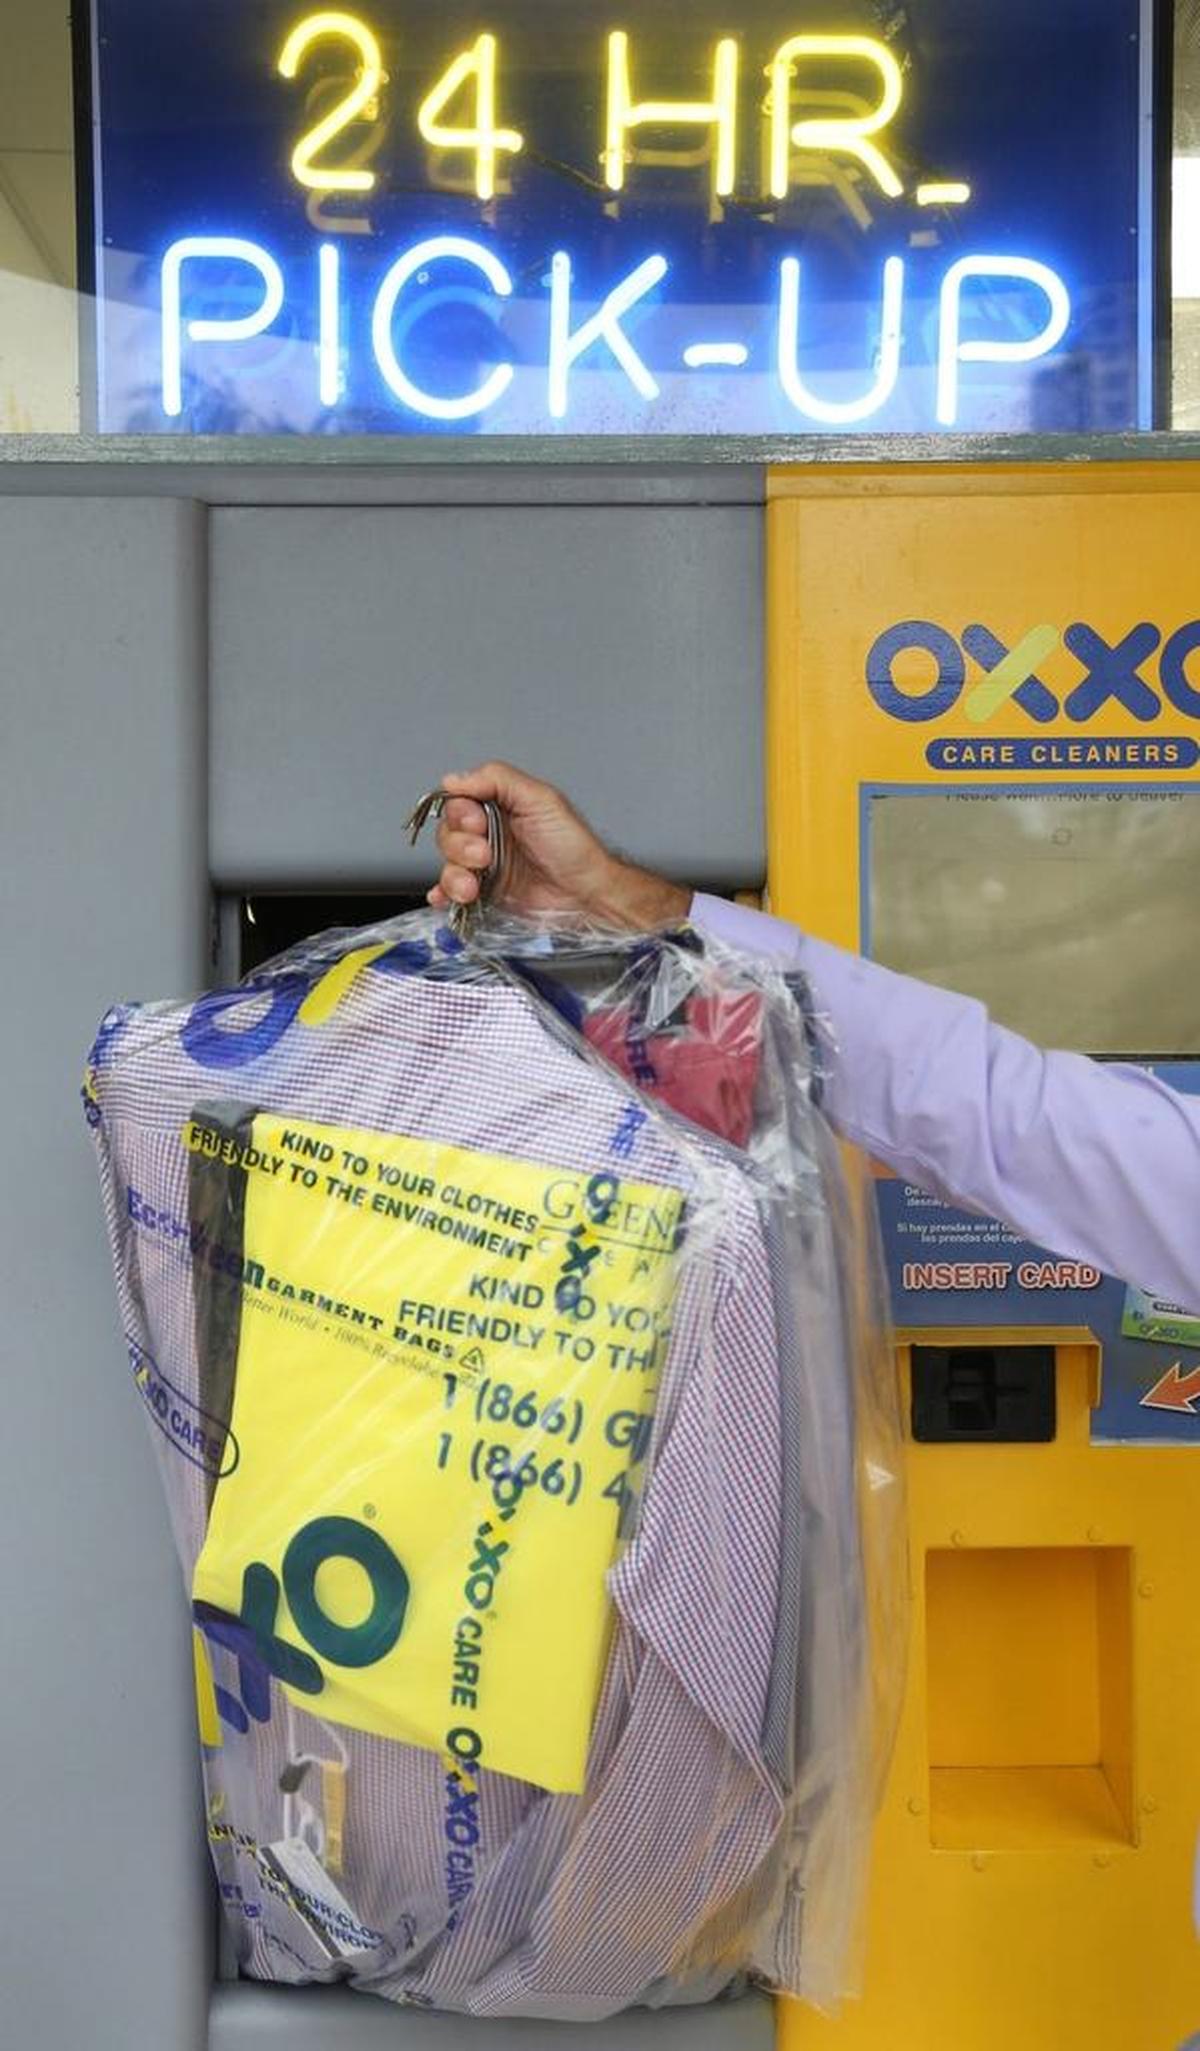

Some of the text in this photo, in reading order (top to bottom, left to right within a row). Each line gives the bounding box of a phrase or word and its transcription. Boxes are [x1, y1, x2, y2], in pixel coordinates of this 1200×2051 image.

[277, 12, 524, 199] 24
[160, 236, 1071, 425] PICK-UP
[943, 744, 1179, 763] CARE CLEANERS
[190, 1126, 533, 1262] FRIENDLY TO THE ENVIRONMENT
[280, 1129, 540, 1234] KIND TO YOUR CLOTHES
[909, 1223, 928, 1235] hay
[929, 1223, 972, 1235] prendas
[938, 1234, 981, 1245] prendas
[982, 1233, 1000, 1242] del
[468, 1274, 544, 1310] KIND
[904, 1261, 1101, 1289] INSERT CARD
[266, 1277, 383, 1331] GARMENT
[393, 1325, 455, 1360] BAGS
[399, 1299, 545, 1350] FRIENDLY
[554, 1331, 596, 1362] TO
[443, 1372, 458, 1410] 1
[476, 1378, 583, 1445] (866)
[437, 1433, 453, 1470] 1
[470, 1439, 582, 1506] (866)
[451, 1616, 483, 1711] CARE
